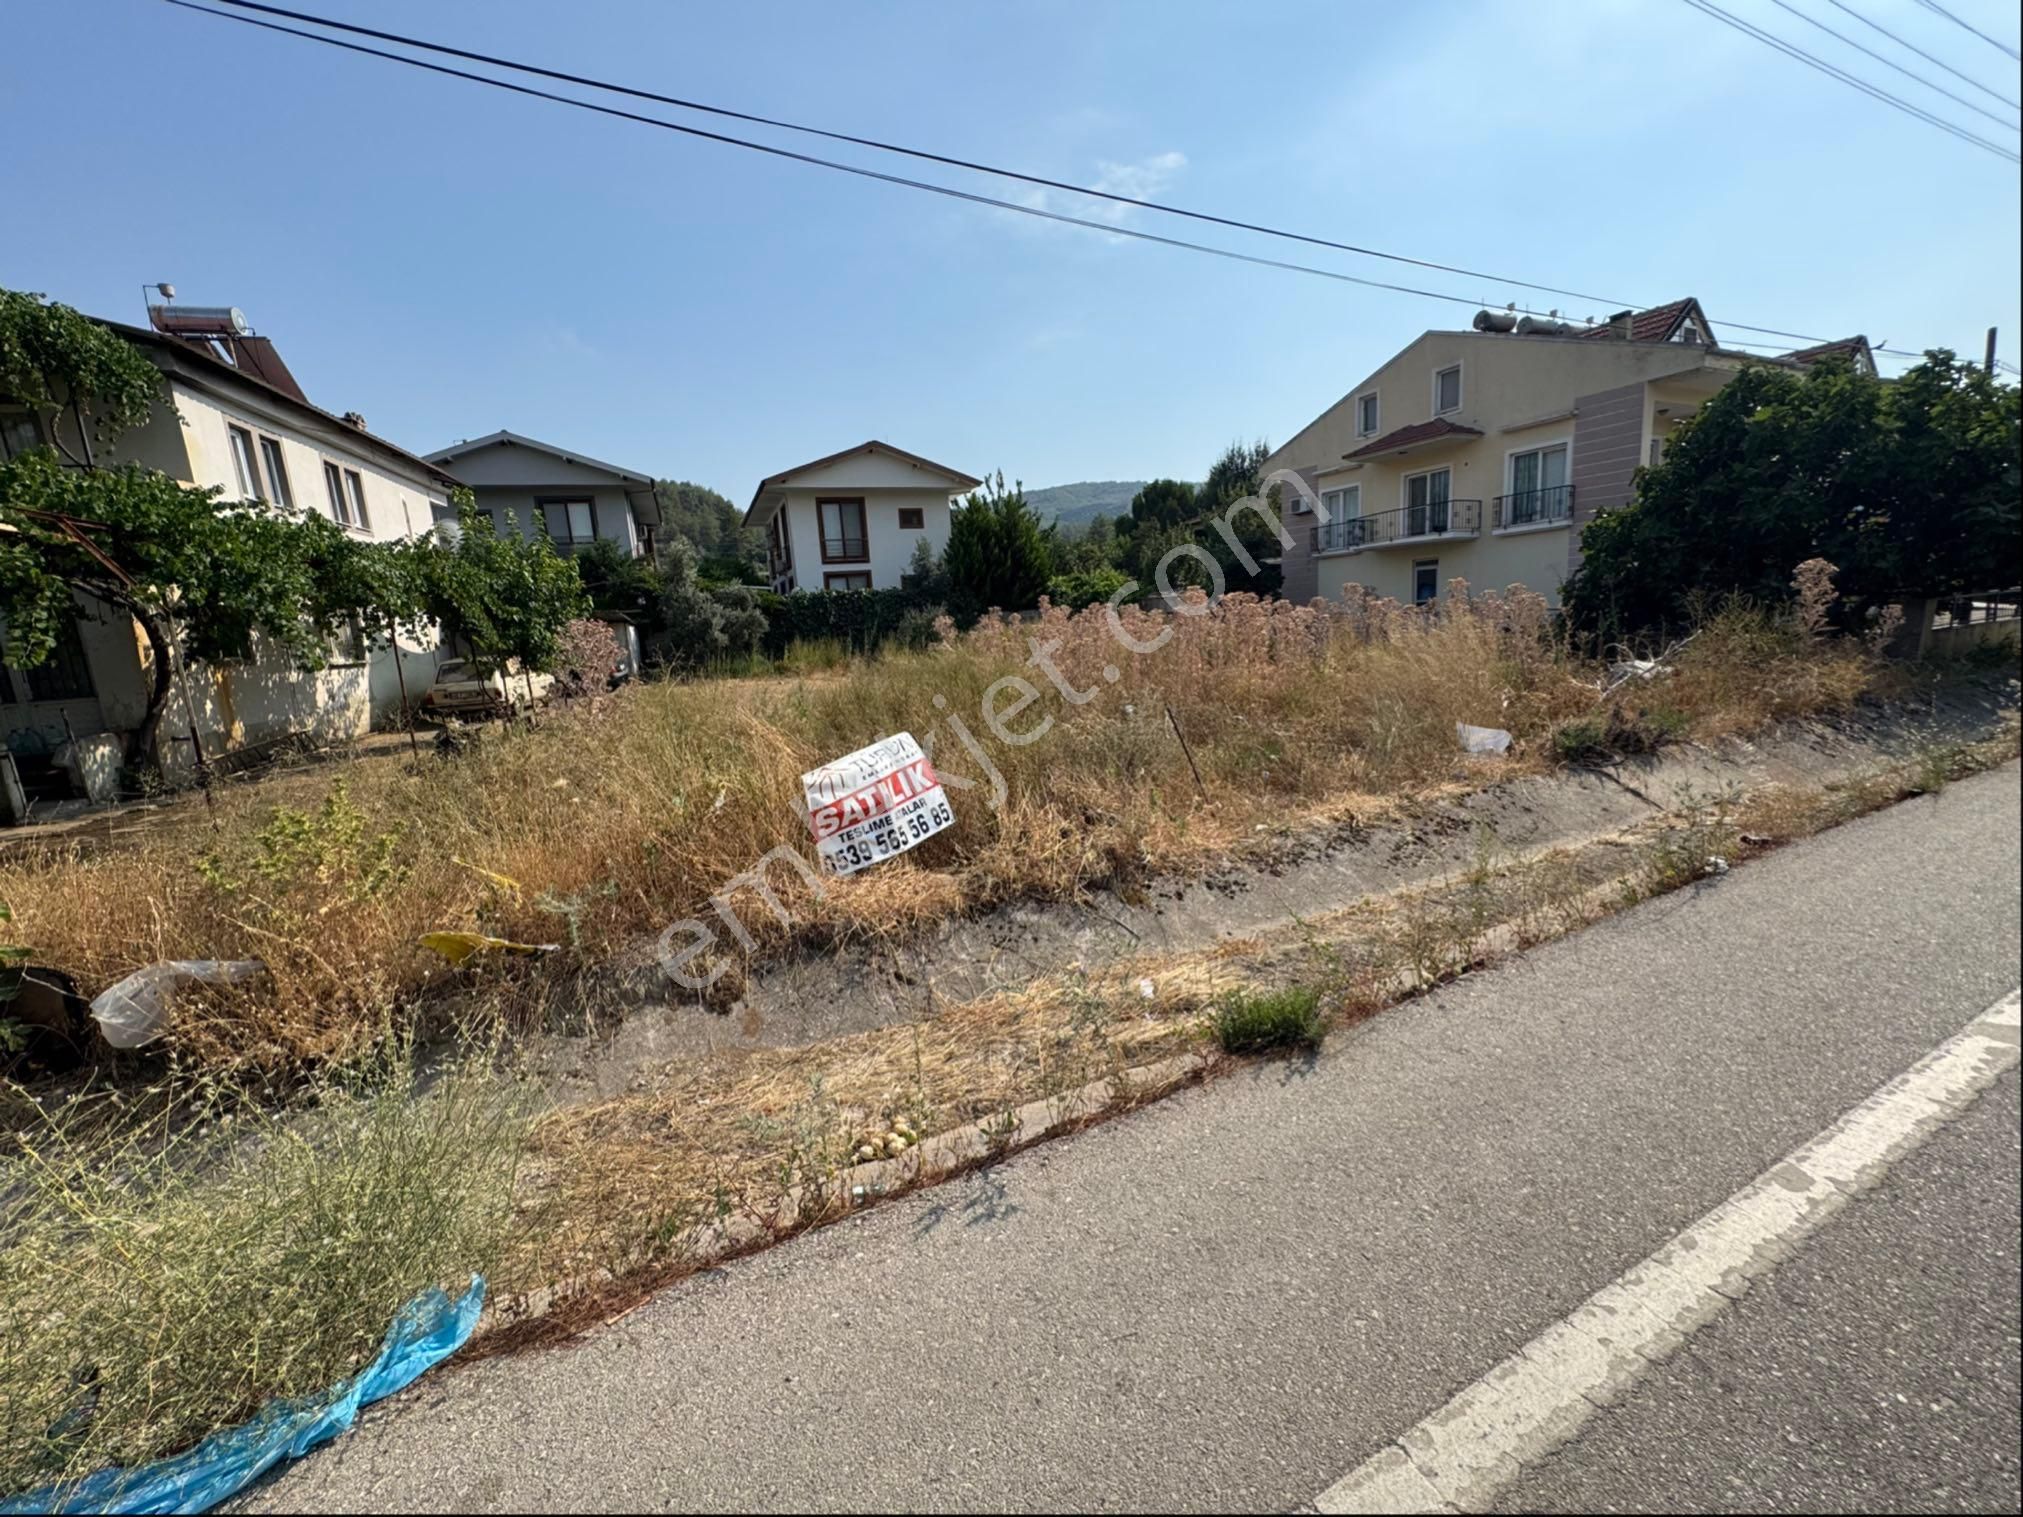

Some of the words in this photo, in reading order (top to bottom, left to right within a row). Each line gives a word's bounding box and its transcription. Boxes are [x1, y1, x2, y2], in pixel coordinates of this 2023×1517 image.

[815, 762, 932, 837] SATILIK
[875, 825, 909, 855] 565
[907, 813, 930, 839] 56
[930, 802, 951, 827] 85
